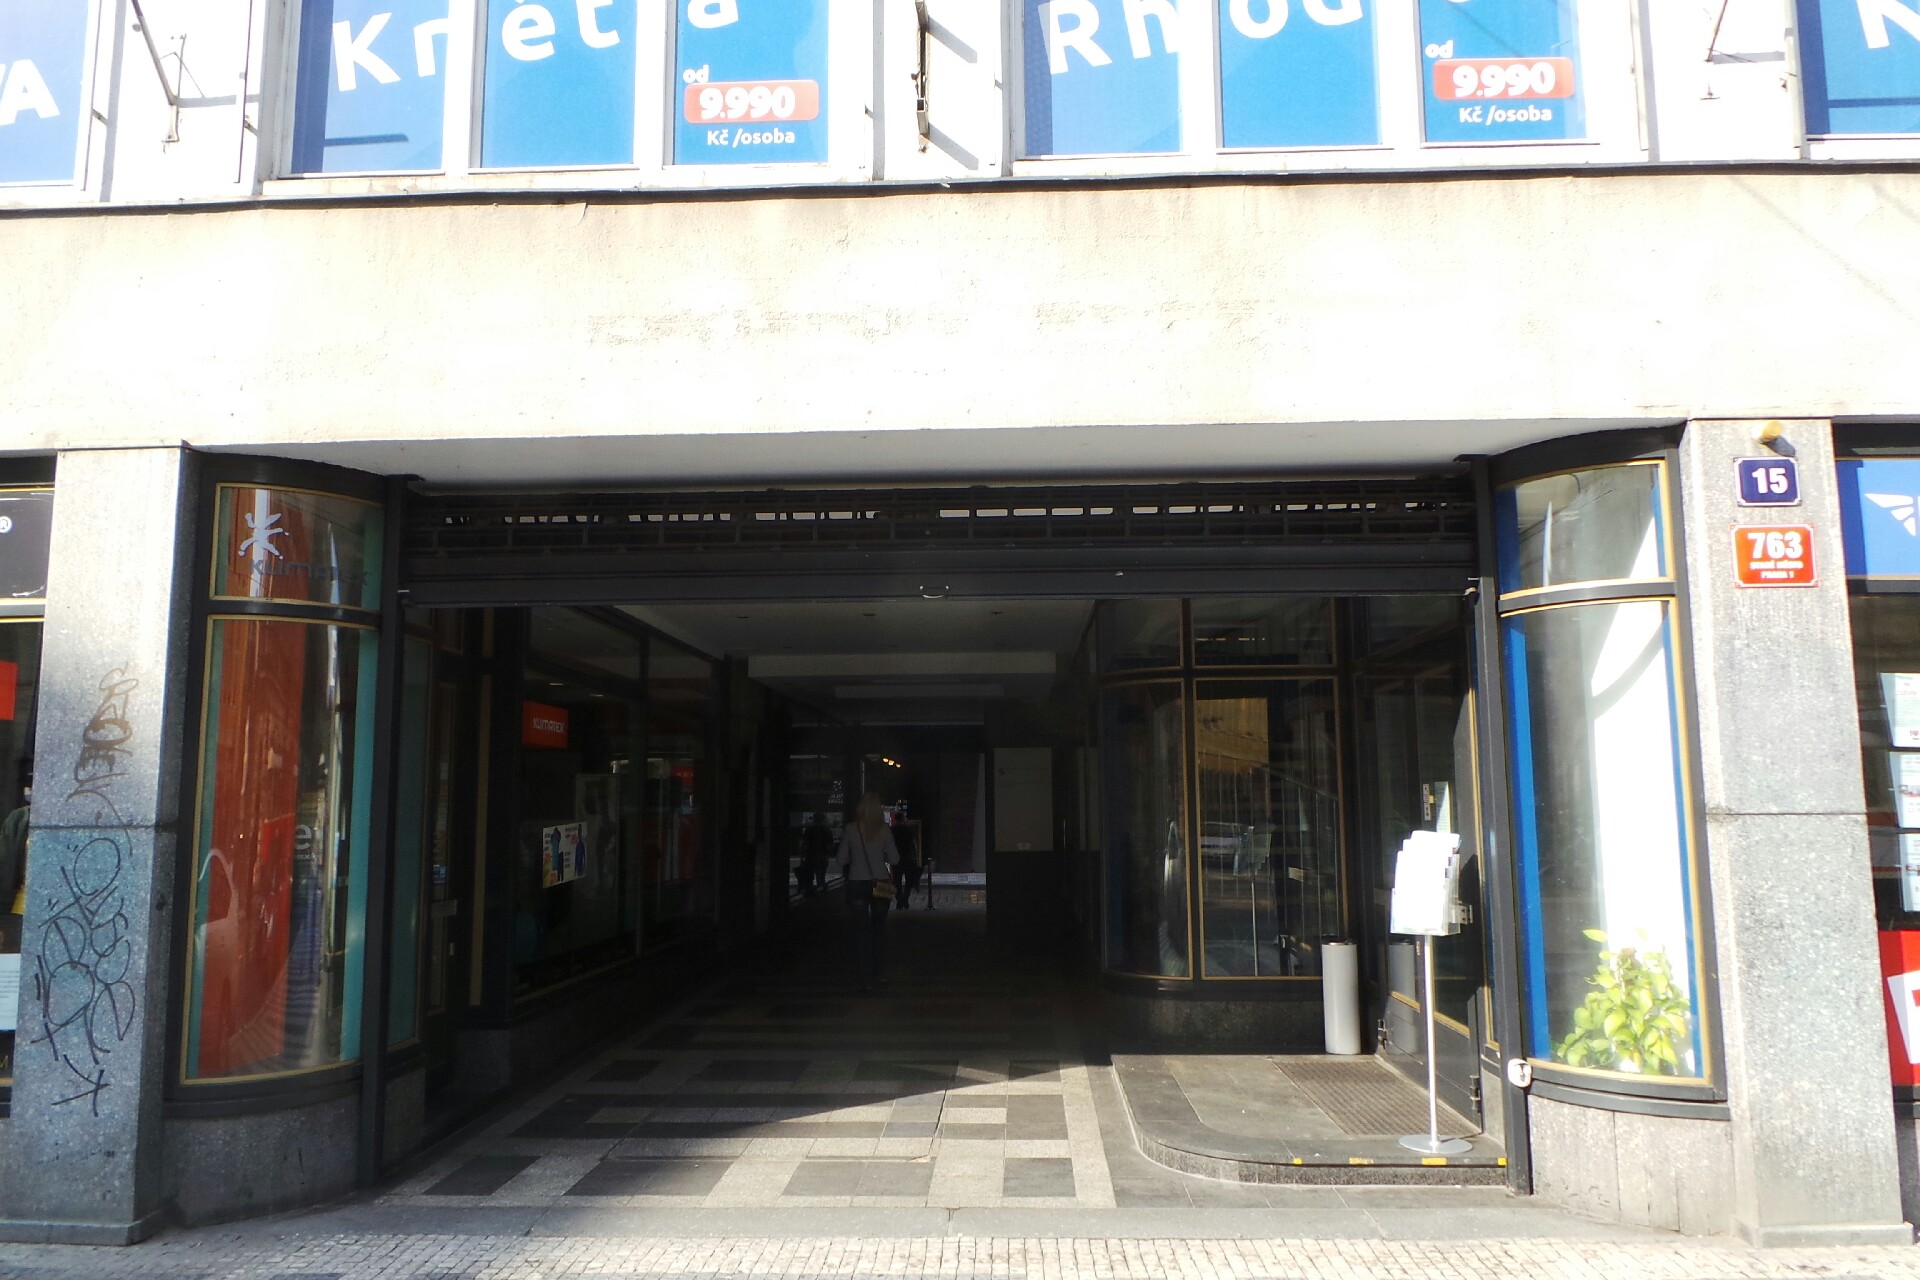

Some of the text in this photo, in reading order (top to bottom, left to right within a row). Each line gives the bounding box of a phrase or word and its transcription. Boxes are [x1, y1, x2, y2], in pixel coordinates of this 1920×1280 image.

[1425, 39, 1453, 58] od
[682, 64, 709, 83] od
[1452, 61, 1556, 98] 9.990
[699, 85, 796, 120] 9.990
[1459, 104, 1552, 126] Kč /osoba
[707, 127, 796, 148] Kč /osoba
[1751, 467, 1789, 494] 15
[1747, 531, 1804, 559] 763
